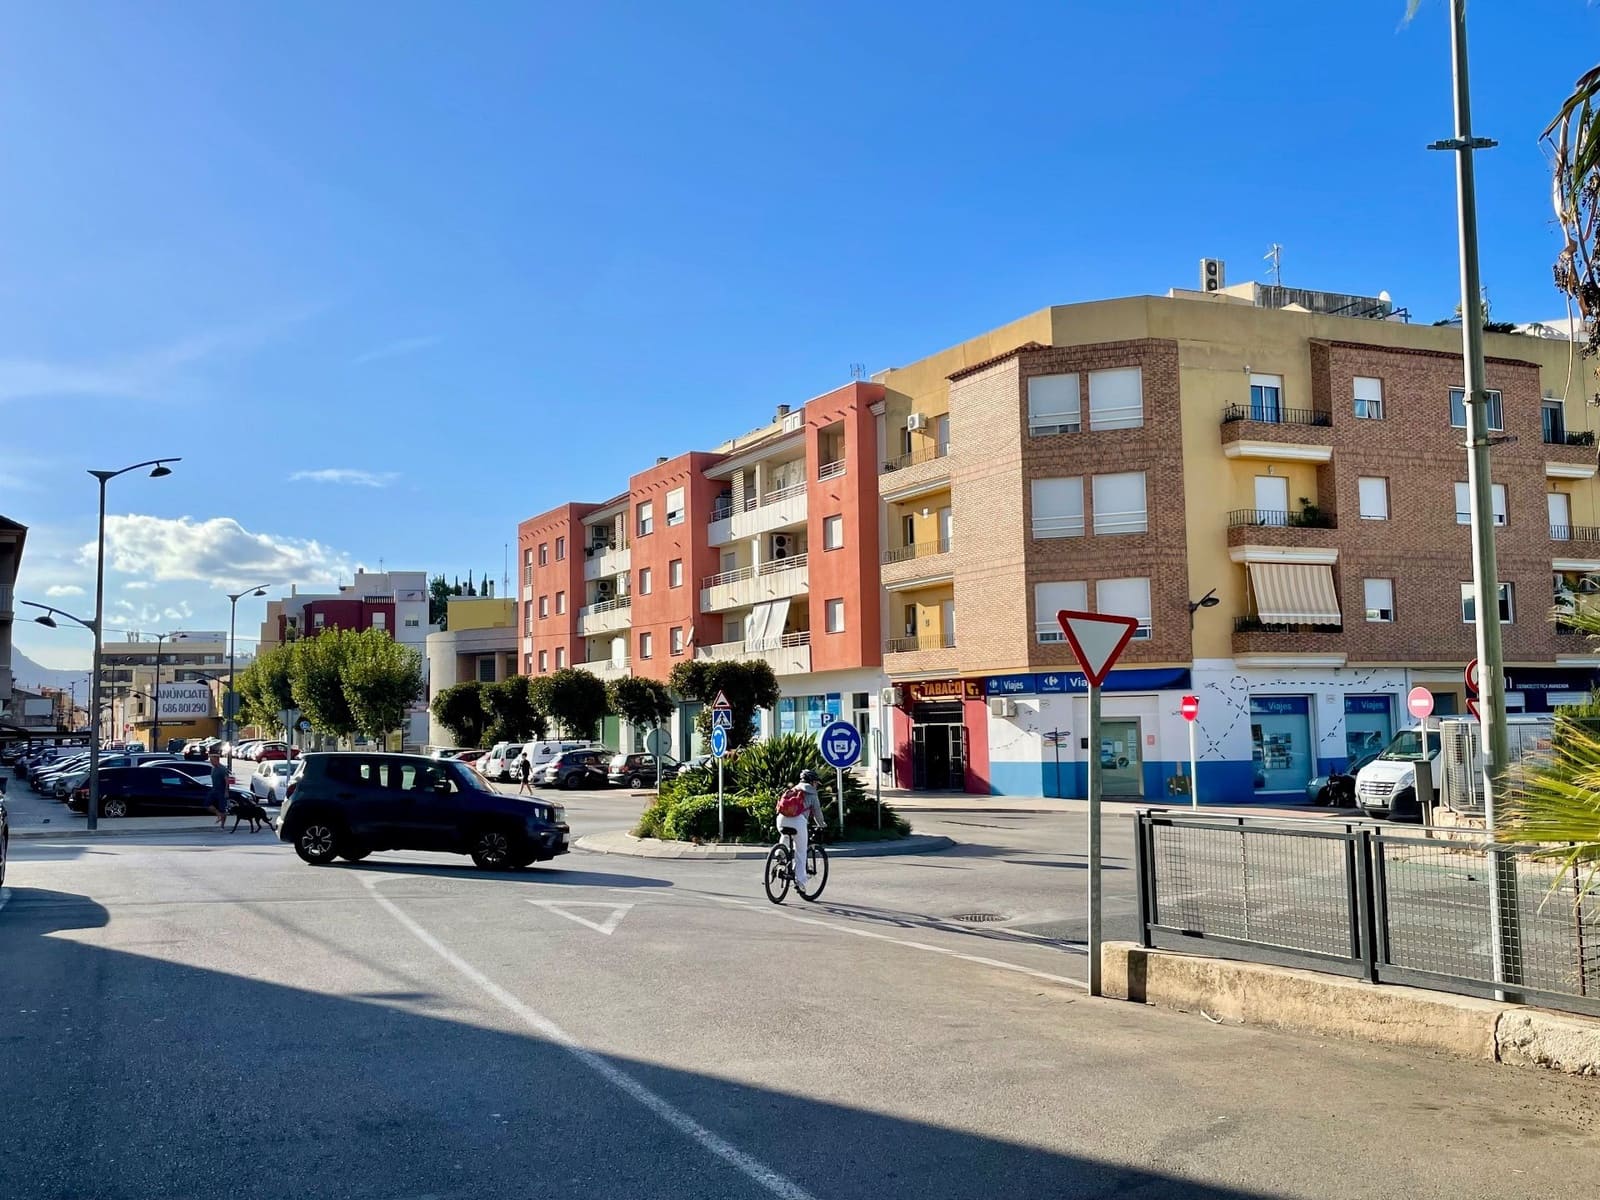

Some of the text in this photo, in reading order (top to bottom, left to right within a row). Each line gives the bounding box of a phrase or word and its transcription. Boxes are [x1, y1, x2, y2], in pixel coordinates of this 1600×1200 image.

[1003, 680, 1024, 692] Viajes
[1070, 677, 1104, 688] Via
[1268, 702, 1292, 713] Viajes
[1361, 701, 1384, 711] Viajes
[823, 714, 831, 725] P
